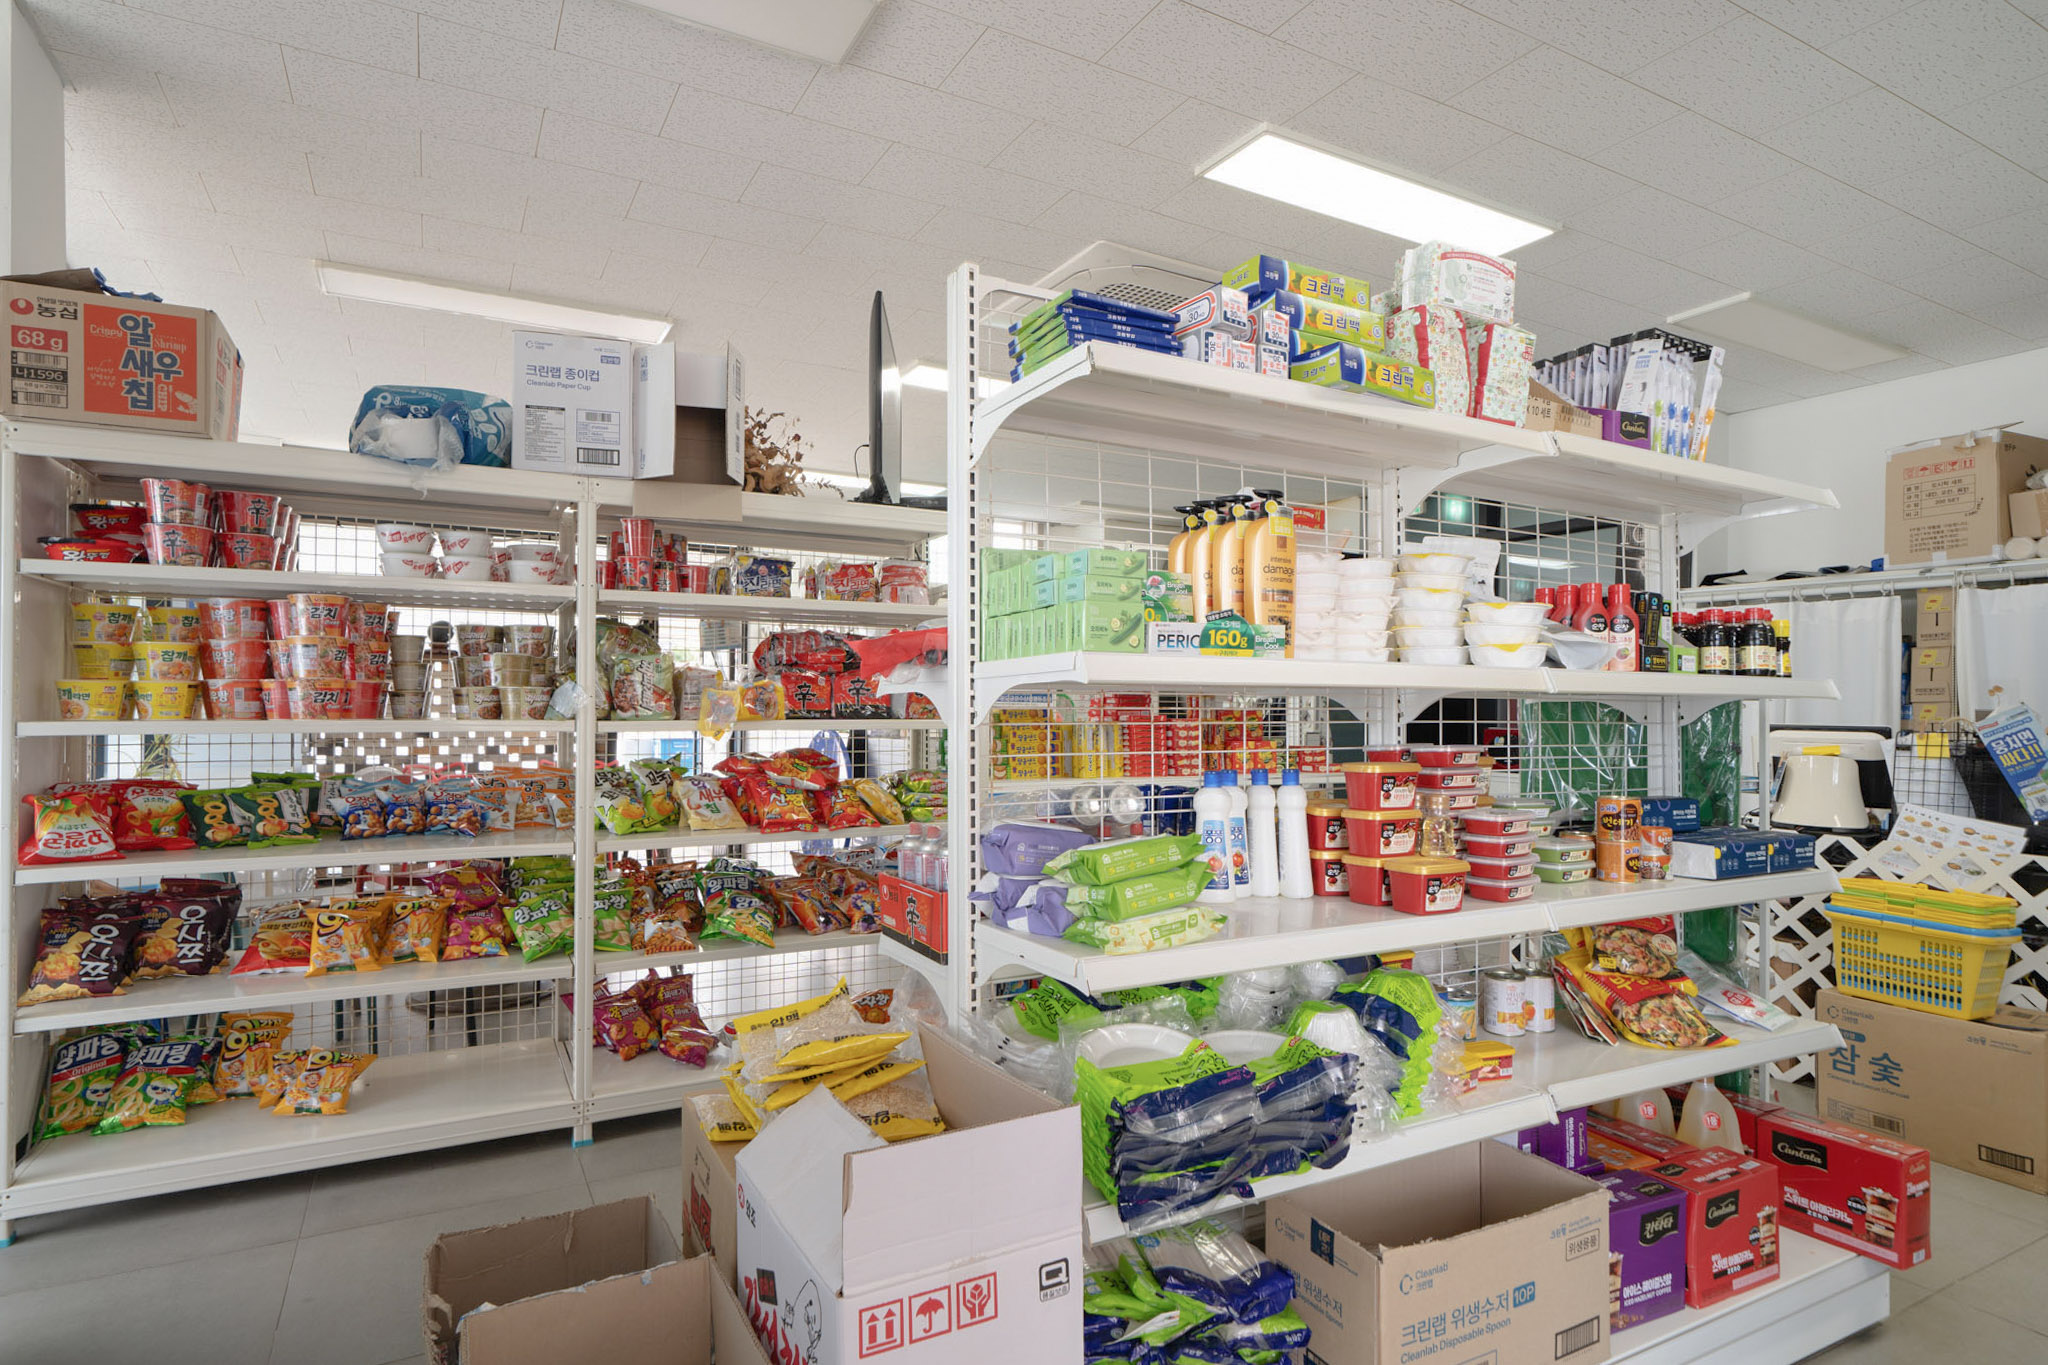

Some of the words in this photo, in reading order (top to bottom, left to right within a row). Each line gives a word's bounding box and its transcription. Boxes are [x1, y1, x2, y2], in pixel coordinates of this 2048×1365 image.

[1306, 278, 1345, 299] 크린백
[37, 303, 78, 320] 농심
[90, 324, 122, 339] Crispy
[119, 314, 154, 348] 알
[1322, 312, 1360, 332] 크린백
[17, 329, 45, 346] 68
[50, 335, 64, 350] g
[154, 338, 187, 354] Shrimp
[15, 367, 64, 381] 나1596
[119, 349, 184, 381] 새우
[526, 364, 561, 379] 크린랩
[565, 367, 600, 382] 종이컵
[527, 379, 556, 388] Cleanlab
[557, 381, 576, 390] Paper
[578, 383, 591, 391] Cup
[1381, 368, 1414, 388] 크린백
[122, 378, 155, 411] 칩
[247, 499, 269, 524] 辛
[163, 530, 187, 557] 辛
[232, 539, 254, 562] 辛
[745, 576, 783, 592] 진라면
[835, 577, 872, 593] 진라면
[310, 606, 338, 620] 김치
[1208, 629, 1248, 648] 160g
[1255, 635, 1277, 643] Breath
[57, 687, 90, 700] 깨라면
[313, 691, 340, 704] 김치
[795, 683, 816, 711] 辛
[849, 678, 870, 706] 辛
[1991, 730, 2037, 755] 뭉치면
[2000, 743, 2043, 768] 싸다!!
[1603, 816, 1634, 827] 번데기
[708, 877, 749, 893] 양파링
[177, 905, 207, 964] 오사쯔
[58, 1035, 120, 1067] 양파링
[127, 1043, 192, 1068] 양파링
[71, 1059, 107, 1076] Original
[1777, 1142, 1822, 1164] Cantata
[1708, 1202, 1736, 1220] Cantata
[1784, 1194, 1809, 1208] 스위트
[1810, 1200, 1853, 1224] 아메리카노
[1847, 1200, 1867, 1210] ZERO
[1807, 1210, 1829, 1222] ZERO
[1644, 1213, 1674, 1239] 칸타타
[1569, 1235, 1597, 1255] 위생용품
[1415, 1262, 1449, 1280] Cleanlab
[1727, 1265, 1741, 1275] ZERO
[1623, 1283, 1642, 1299] 아이스
[1656, 1285, 1672, 1297] COFFEE
[1401, 1313, 1446, 1347] 크린랩
[1451, 1290, 1510, 1330] 위생수저
[1514, 1286, 1534, 1305] 10P
[1401, 1345, 1438, 1365] Cleanlab
[1440, 1328, 1484, 1351] Disposable
[1485, 1318, 1511, 1335] Spoon
